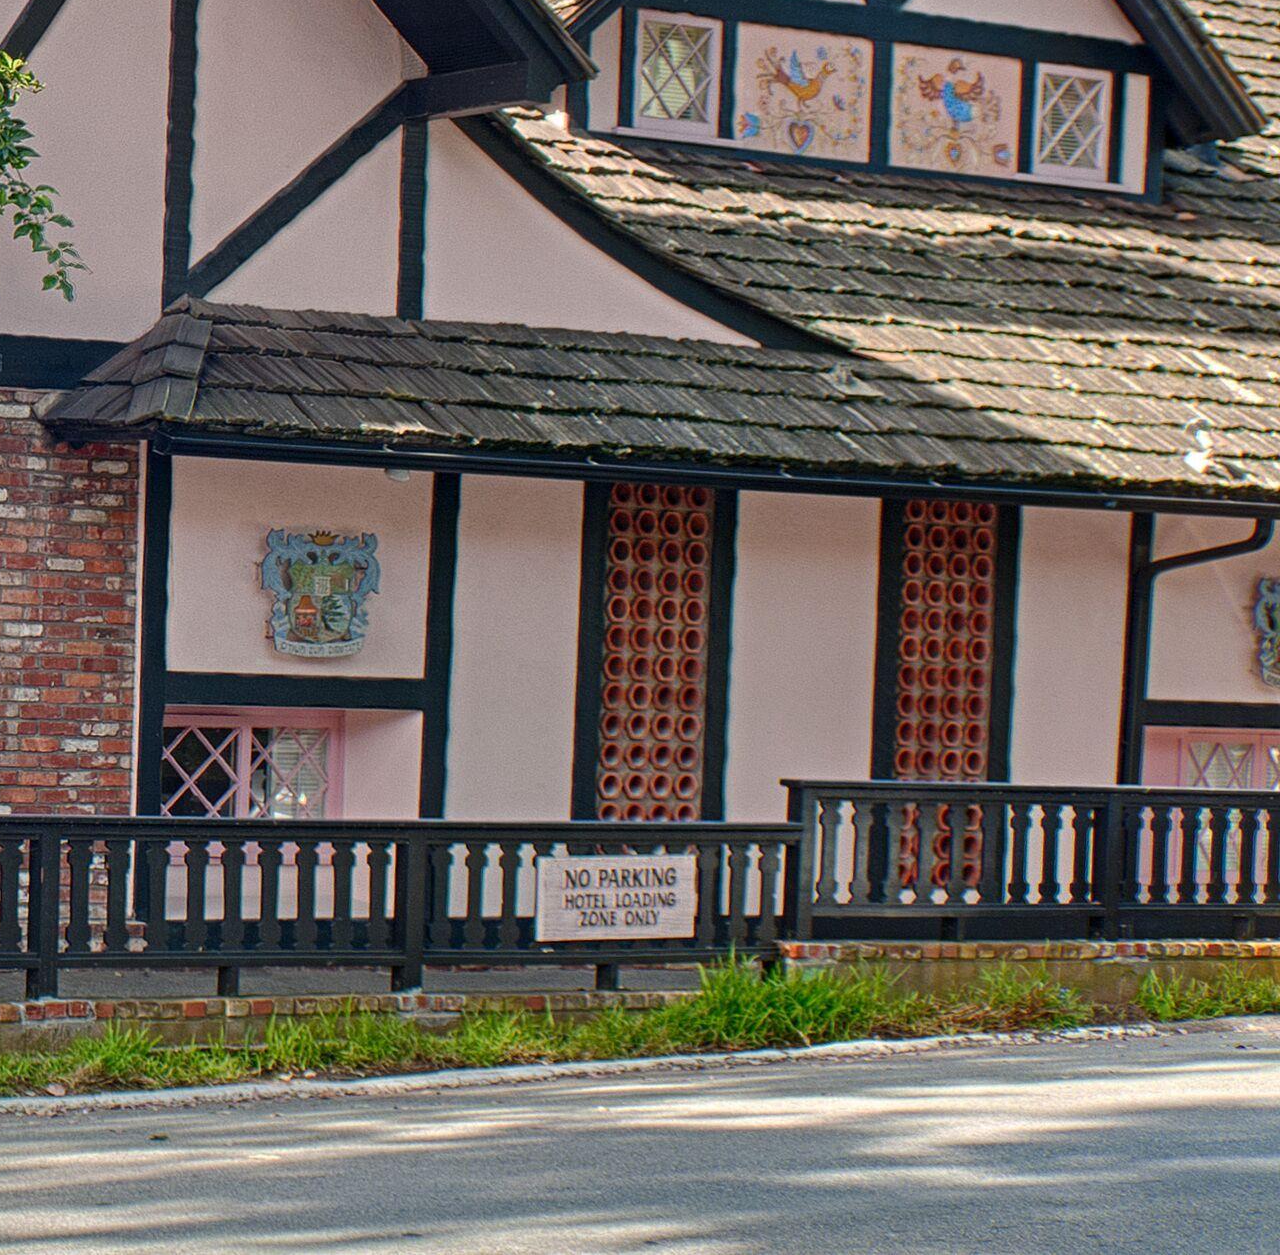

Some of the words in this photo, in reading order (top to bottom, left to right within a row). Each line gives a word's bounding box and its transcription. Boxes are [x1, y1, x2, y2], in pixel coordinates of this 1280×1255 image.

[564, 869, 591, 888] NO
[598, 867, 677, 888] PARKING
[564, 894, 606, 909] HOTEL
[615, 892, 677, 908] LOADING
[579, 911, 618, 926] ZONE
[624, 910, 660, 926] ONLY
